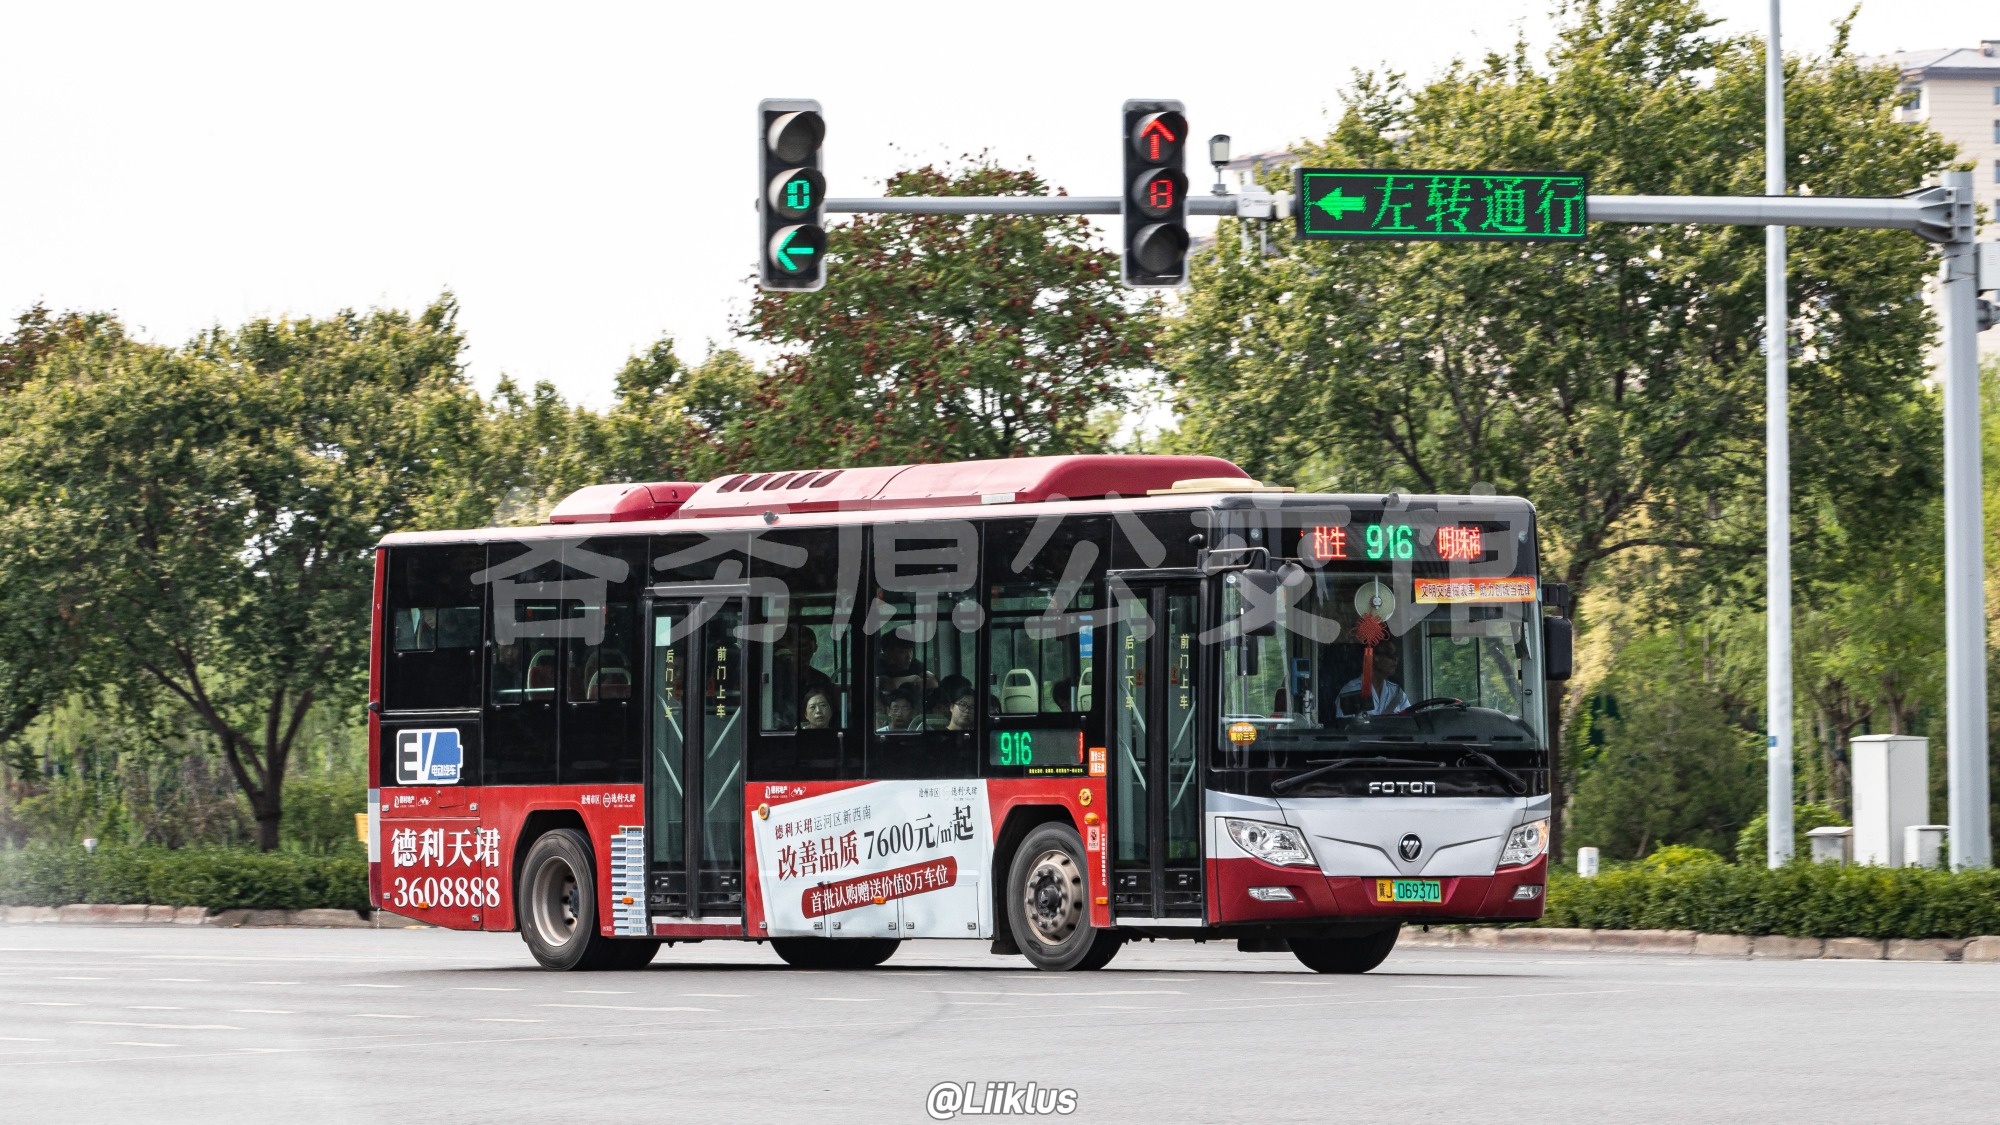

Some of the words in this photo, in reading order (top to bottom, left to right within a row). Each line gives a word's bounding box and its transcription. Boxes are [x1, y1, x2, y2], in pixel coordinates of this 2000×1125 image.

[1372, 176, 1582, 234] 左转通行
[1314, 526, 1347, 558] 杜生
[1366, 525, 1413, 559] 916
[665, 649, 674, 719] 后门下车
[716, 646, 727, 718] 前门上车
[1125, 635, 1134, 710] 后门下车
[1180, 634, 1190, 709] 前门上车
[1001, 731, 1032, 765] 916
[1368, 781, 1436, 794] FOTON
[391, 828, 501, 868] 德利天珺
[777, 829, 860, 882] 改善品质
[394, 877, 501, 908] 3608888
[810, 864, 949, 914] 首批认购赠送价值8万车位
